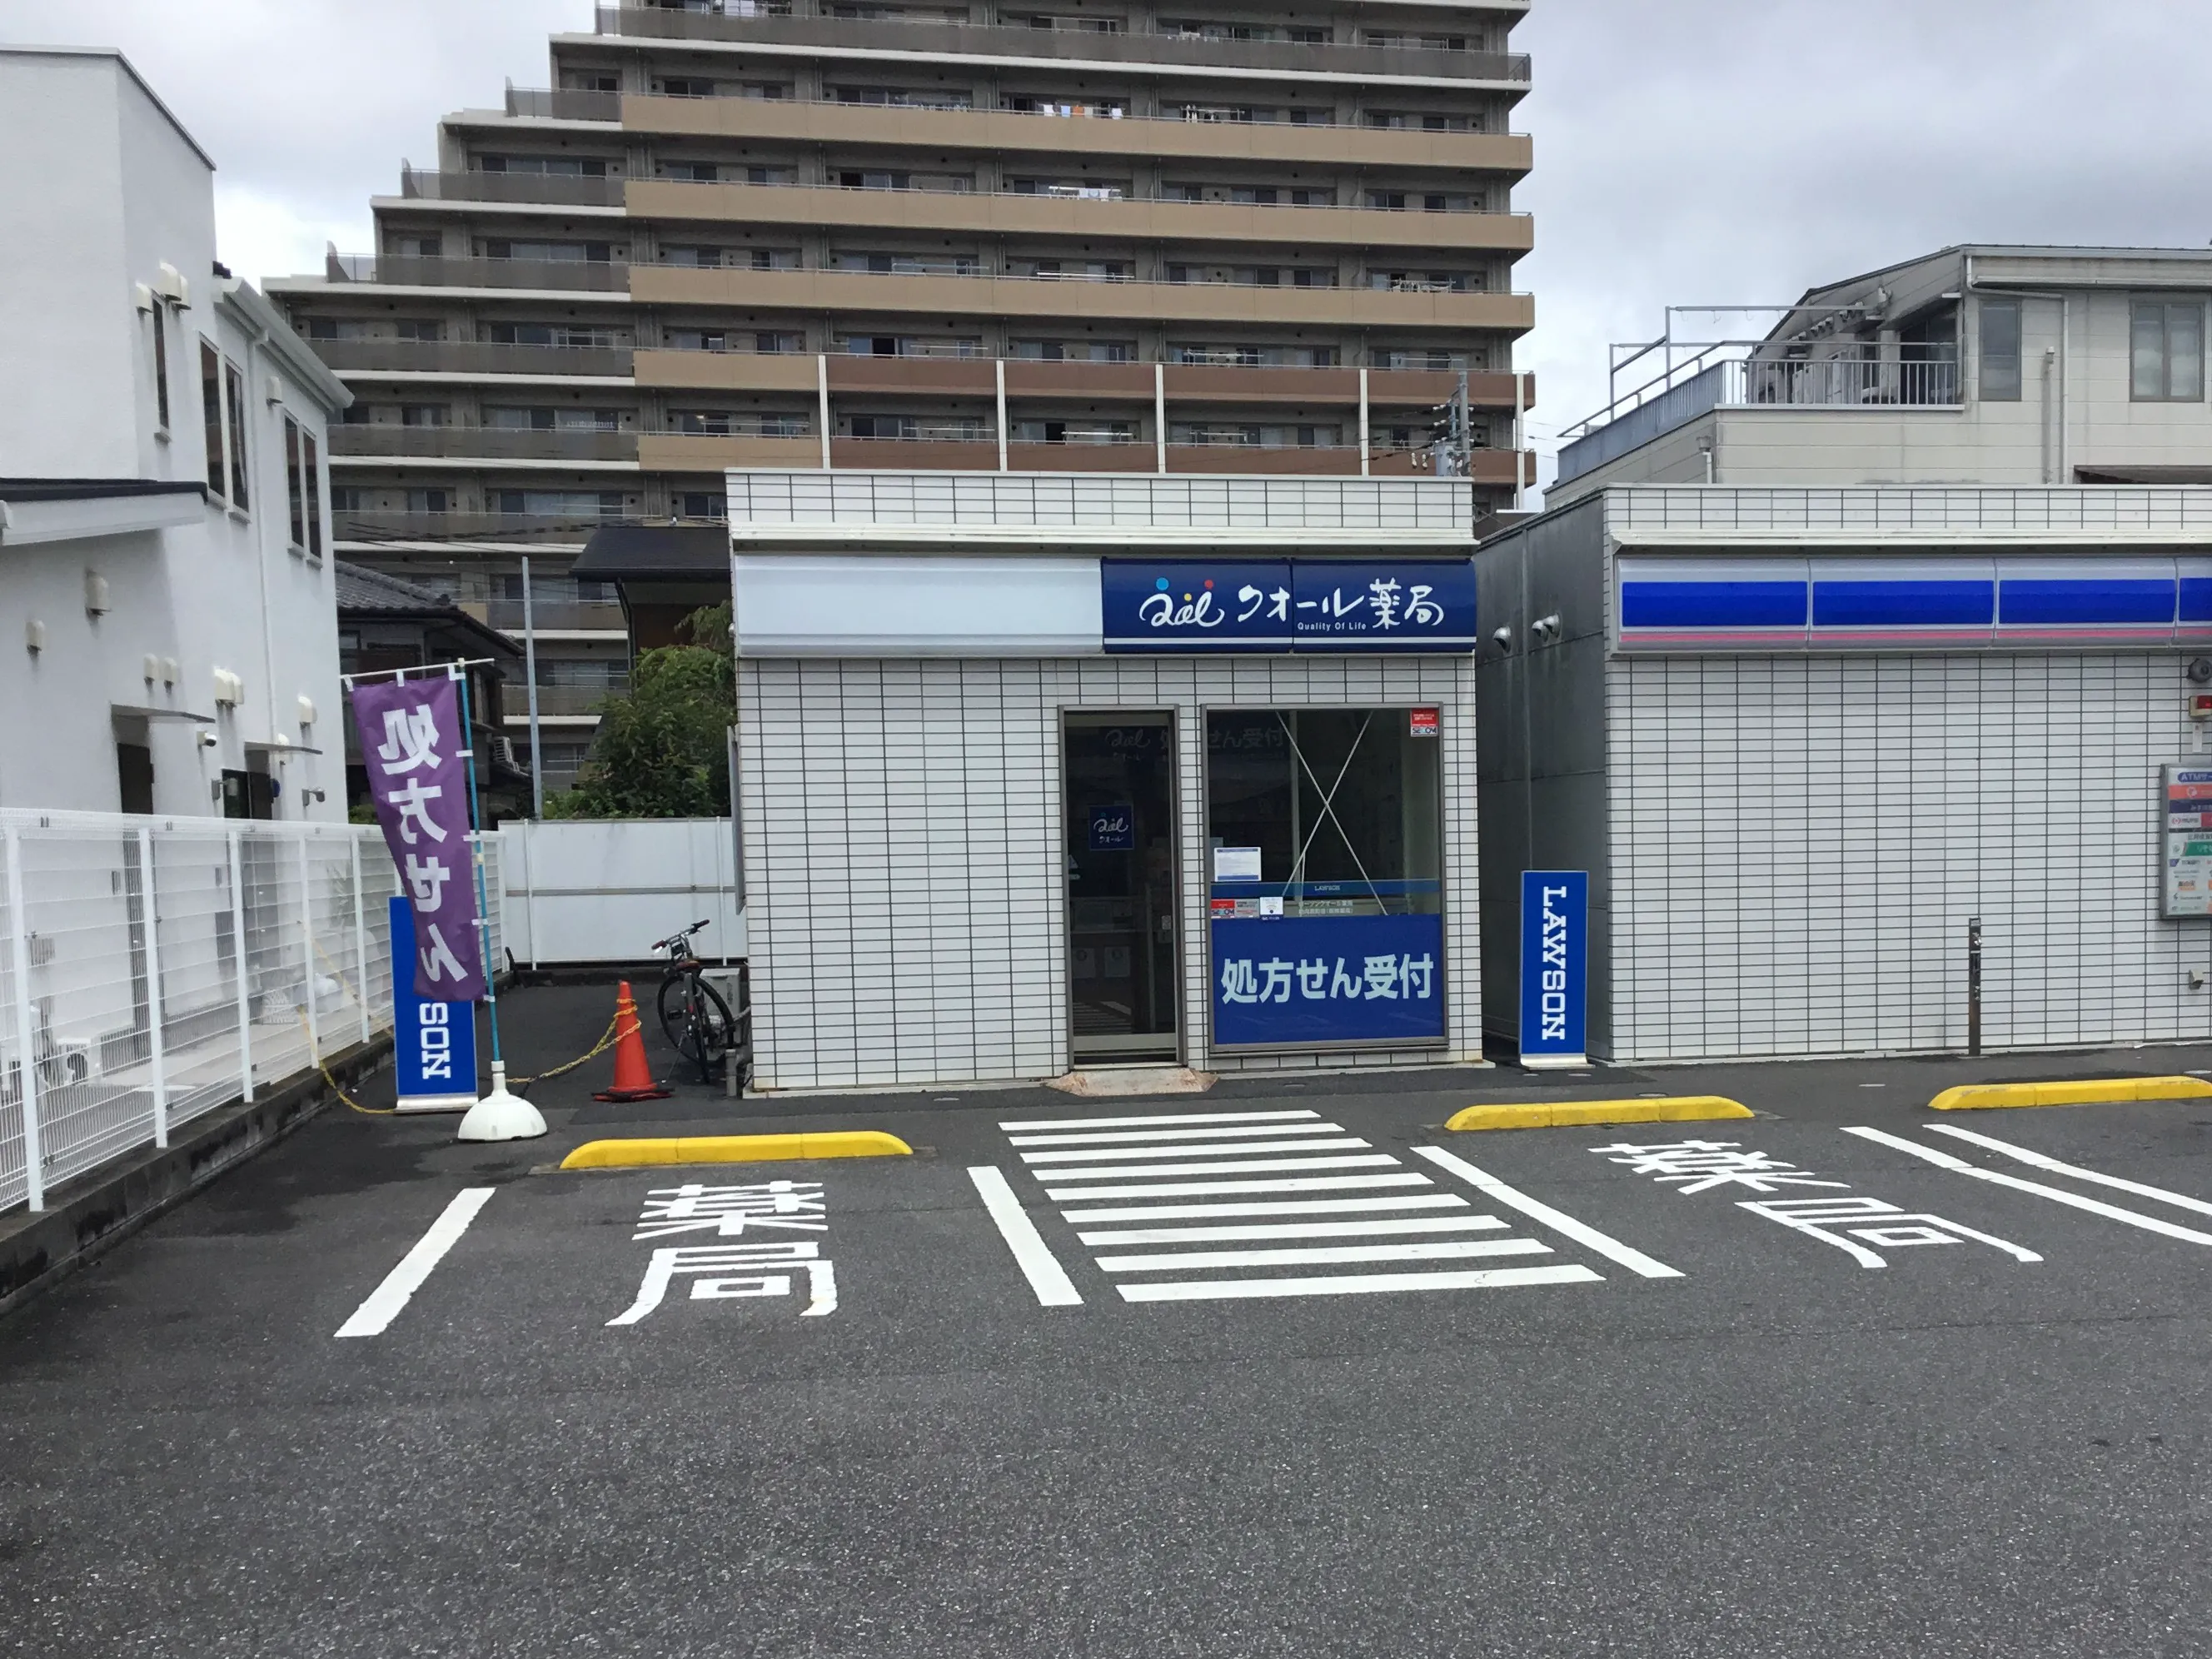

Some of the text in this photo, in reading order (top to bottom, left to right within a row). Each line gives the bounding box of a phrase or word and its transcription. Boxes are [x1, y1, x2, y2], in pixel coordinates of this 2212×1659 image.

[1237, 576, 1445, 630] クオール薬局
[1298, 622, 1331, 631] Quality
[1221, 953, 1434, 1004] 処方せん受付
[1542, 886, 1567, 1040] LAWSON
[419, 1002, 451, 1079] SON
[1587, 1139, 2045, 1268] 薬局
[605, 1180, 839, 1326] 薬局
